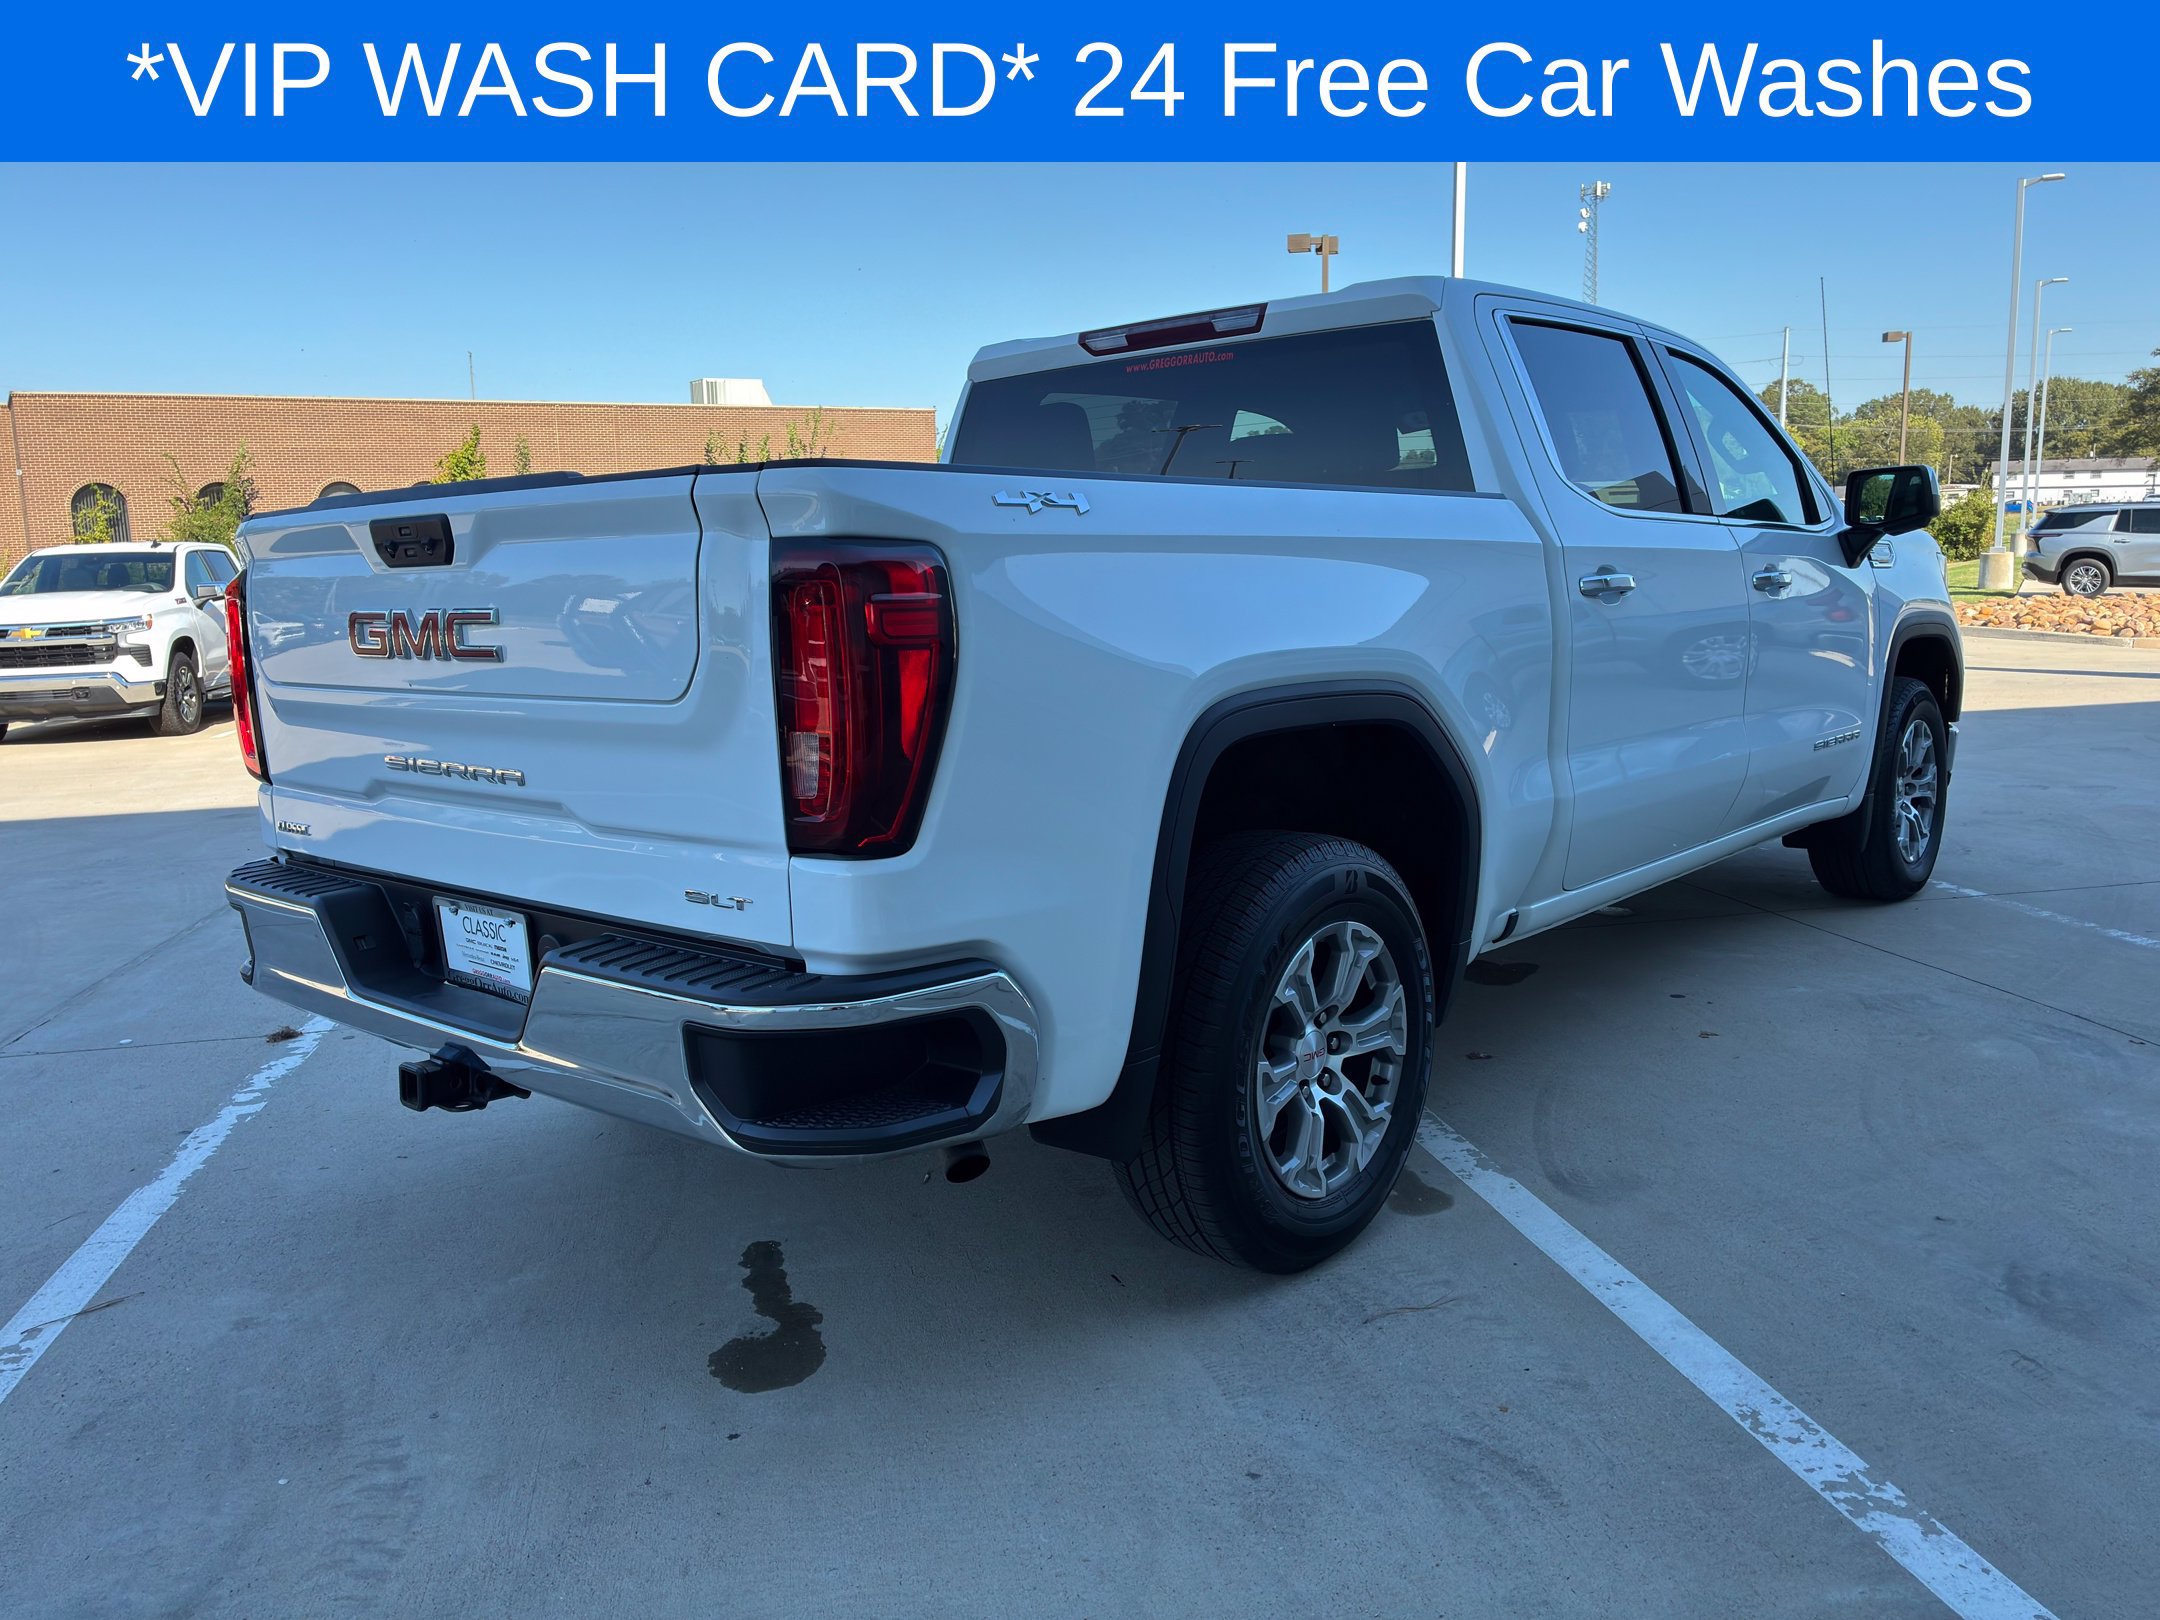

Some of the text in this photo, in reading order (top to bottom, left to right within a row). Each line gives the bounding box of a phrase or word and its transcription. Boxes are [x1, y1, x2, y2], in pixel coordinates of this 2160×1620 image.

[1125, 350, 1234, 374] www.GREGGORRAUTO.com
[348, 607, 504, 663] GMC
[1813, 729, 1861, 752] SIERRA
[384, 754, 526, 787] SIERRA
[684, 889, 754, 911] SLT
[462, 916, 506, 942] CLASSIC
